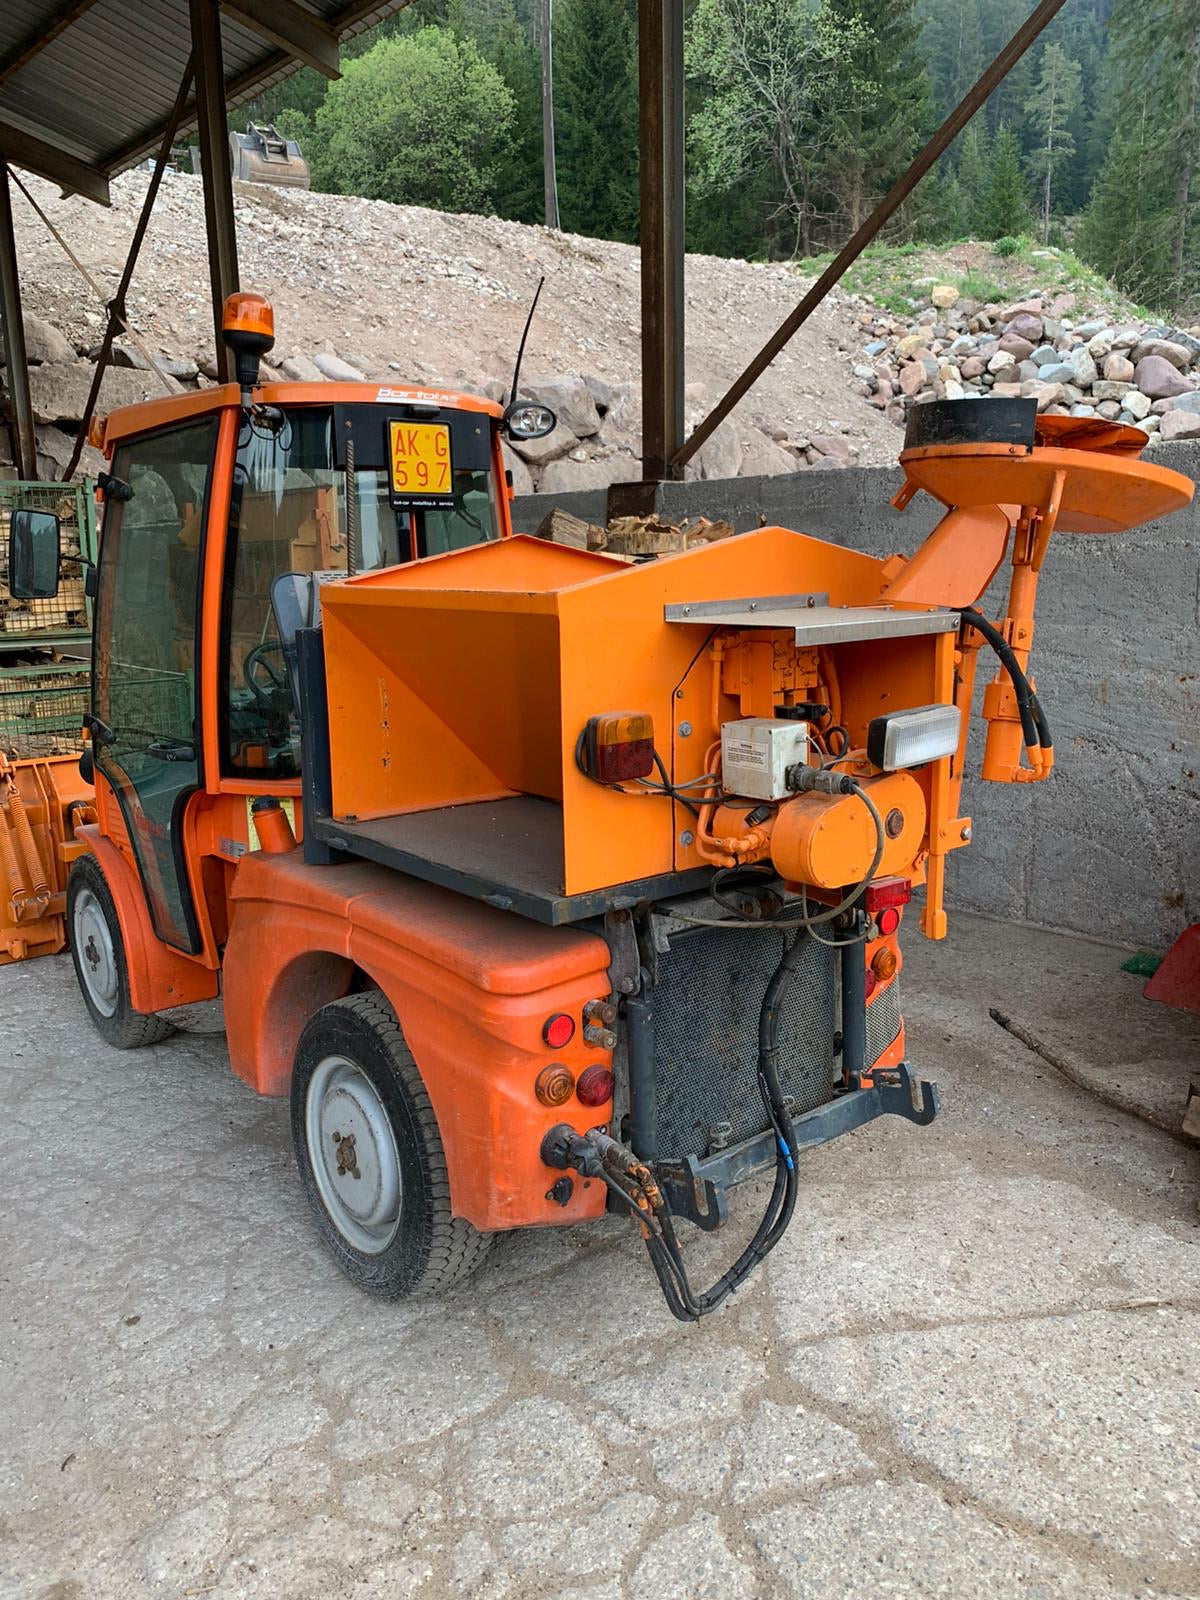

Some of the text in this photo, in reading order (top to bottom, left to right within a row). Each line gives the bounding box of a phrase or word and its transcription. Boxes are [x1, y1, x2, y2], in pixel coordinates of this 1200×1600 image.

[395, 429, 447, 457] AK G
[395, 460, 448, 487] 597
